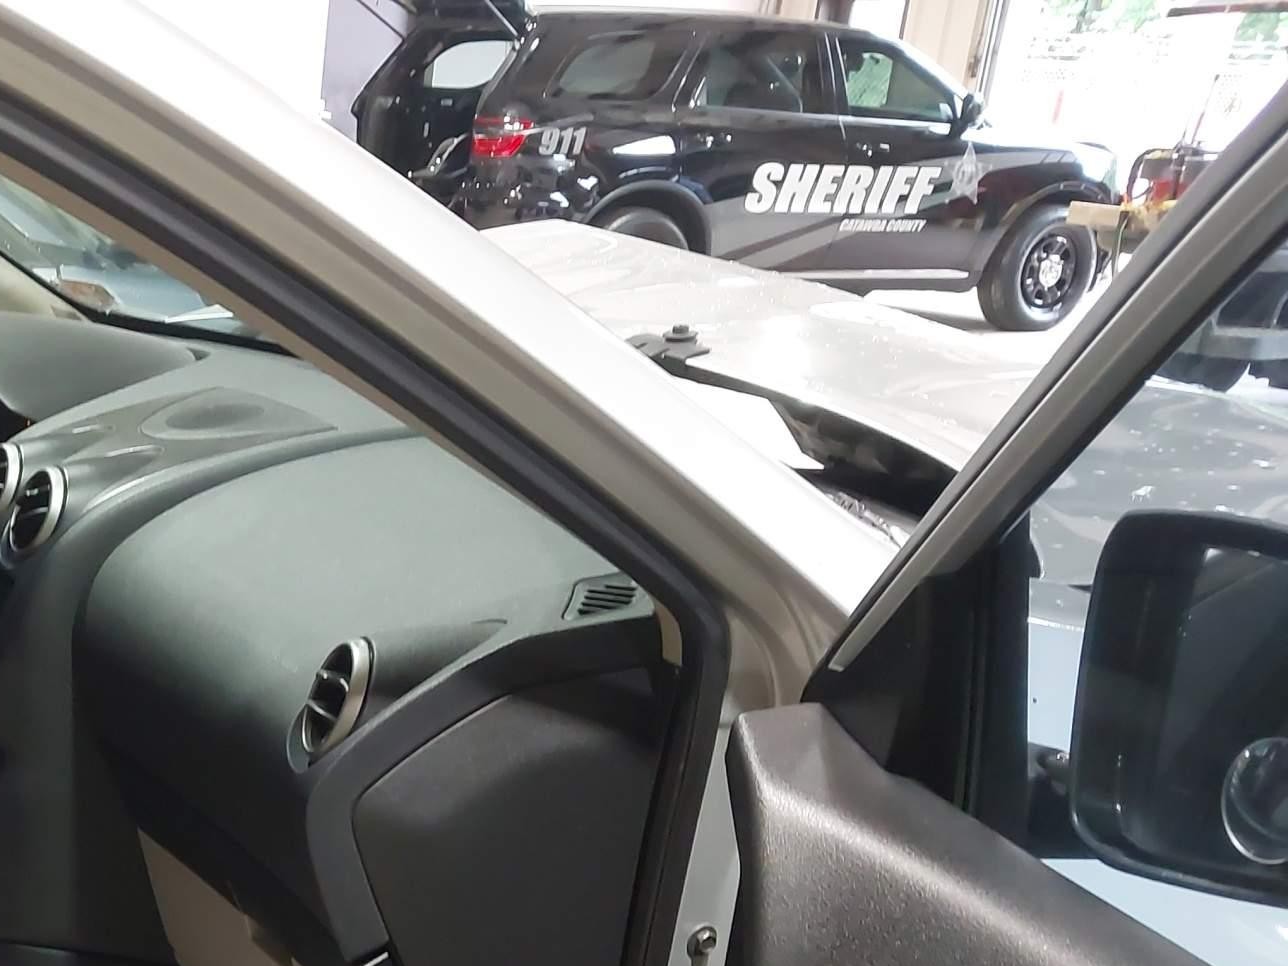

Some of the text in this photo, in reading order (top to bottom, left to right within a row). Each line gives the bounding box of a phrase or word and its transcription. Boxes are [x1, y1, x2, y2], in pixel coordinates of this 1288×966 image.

[538, 126, 587, 156] 911
[744, 162, 942, 215] SHERIFF
[886, 219, 927, 232] COUNTY
